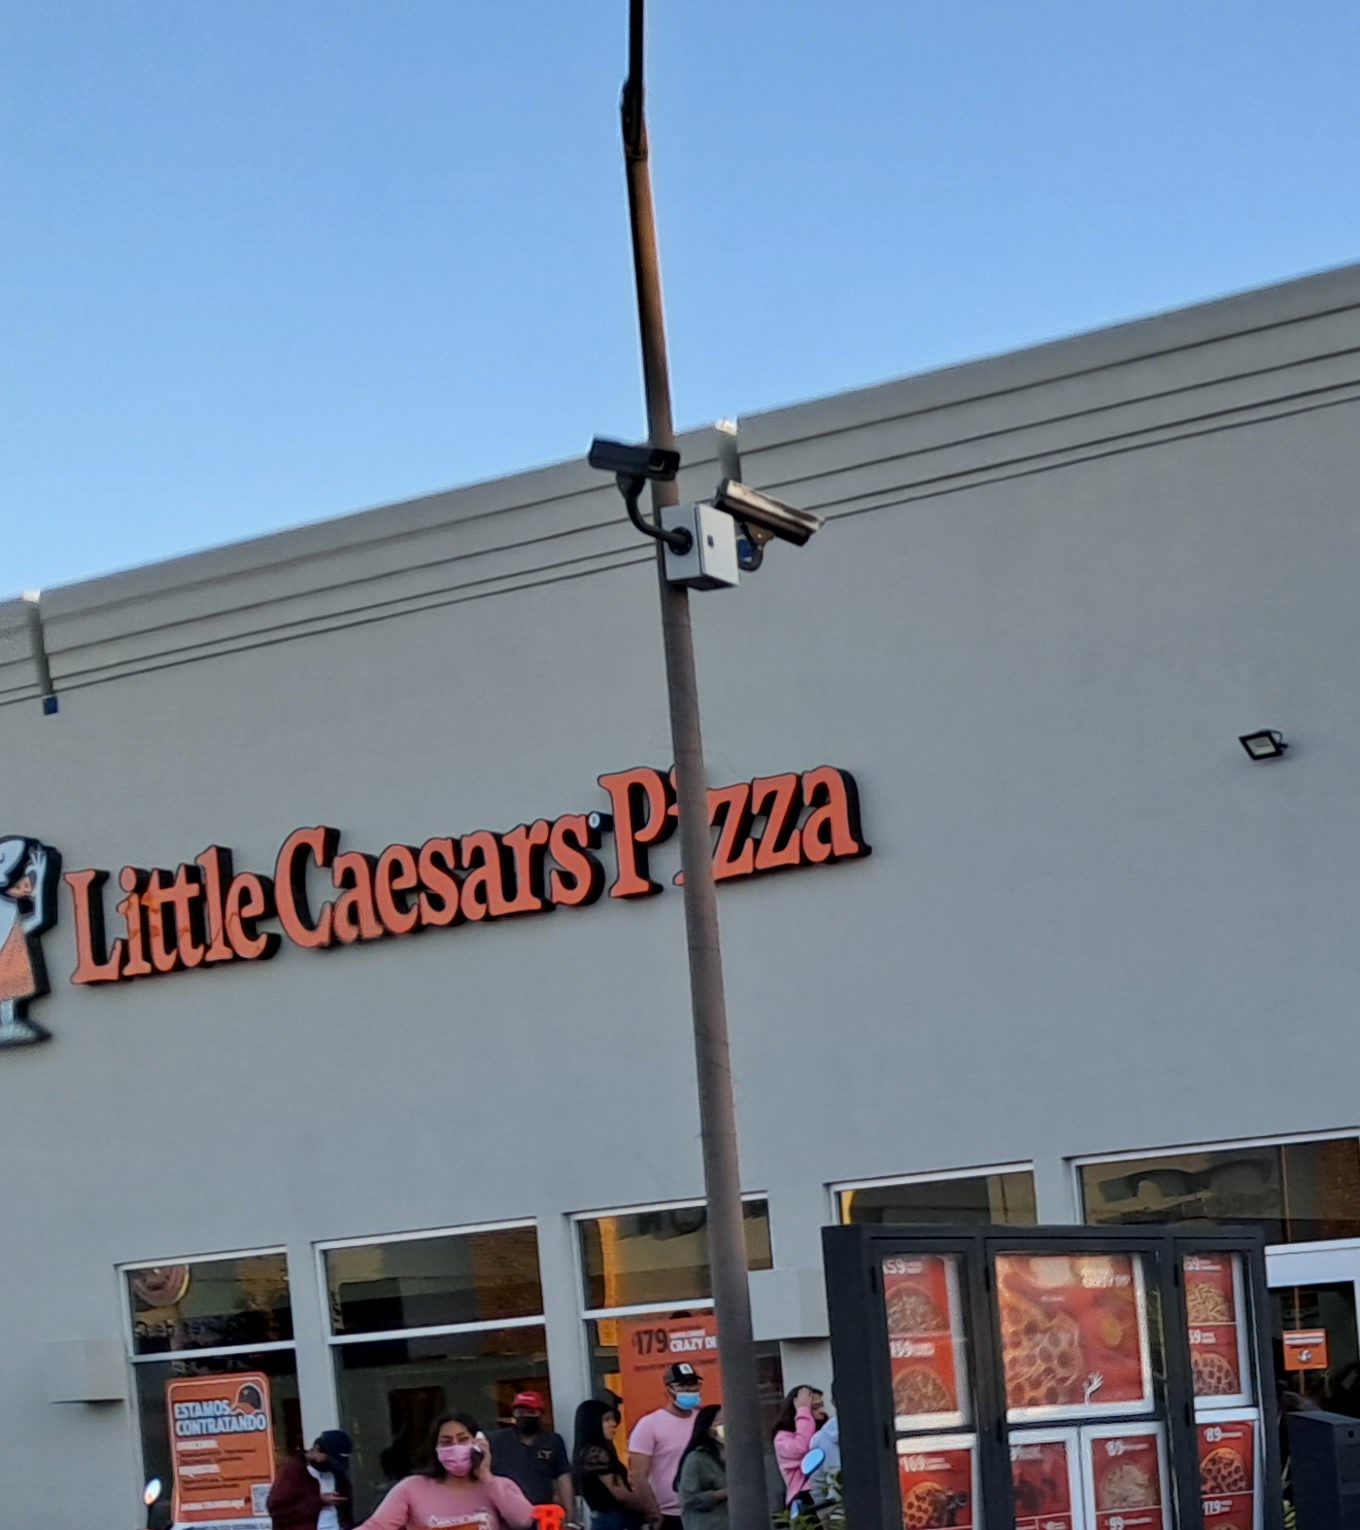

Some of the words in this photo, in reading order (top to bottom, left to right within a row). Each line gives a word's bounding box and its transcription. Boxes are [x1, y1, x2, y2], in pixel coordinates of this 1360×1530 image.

[63, 845, 281, 986] Little
[274, 811, 607, 949] Caesars
[598, 764, 873, 900] Pzza
[175, 1413, 268, 1437] CONTRATANDO
